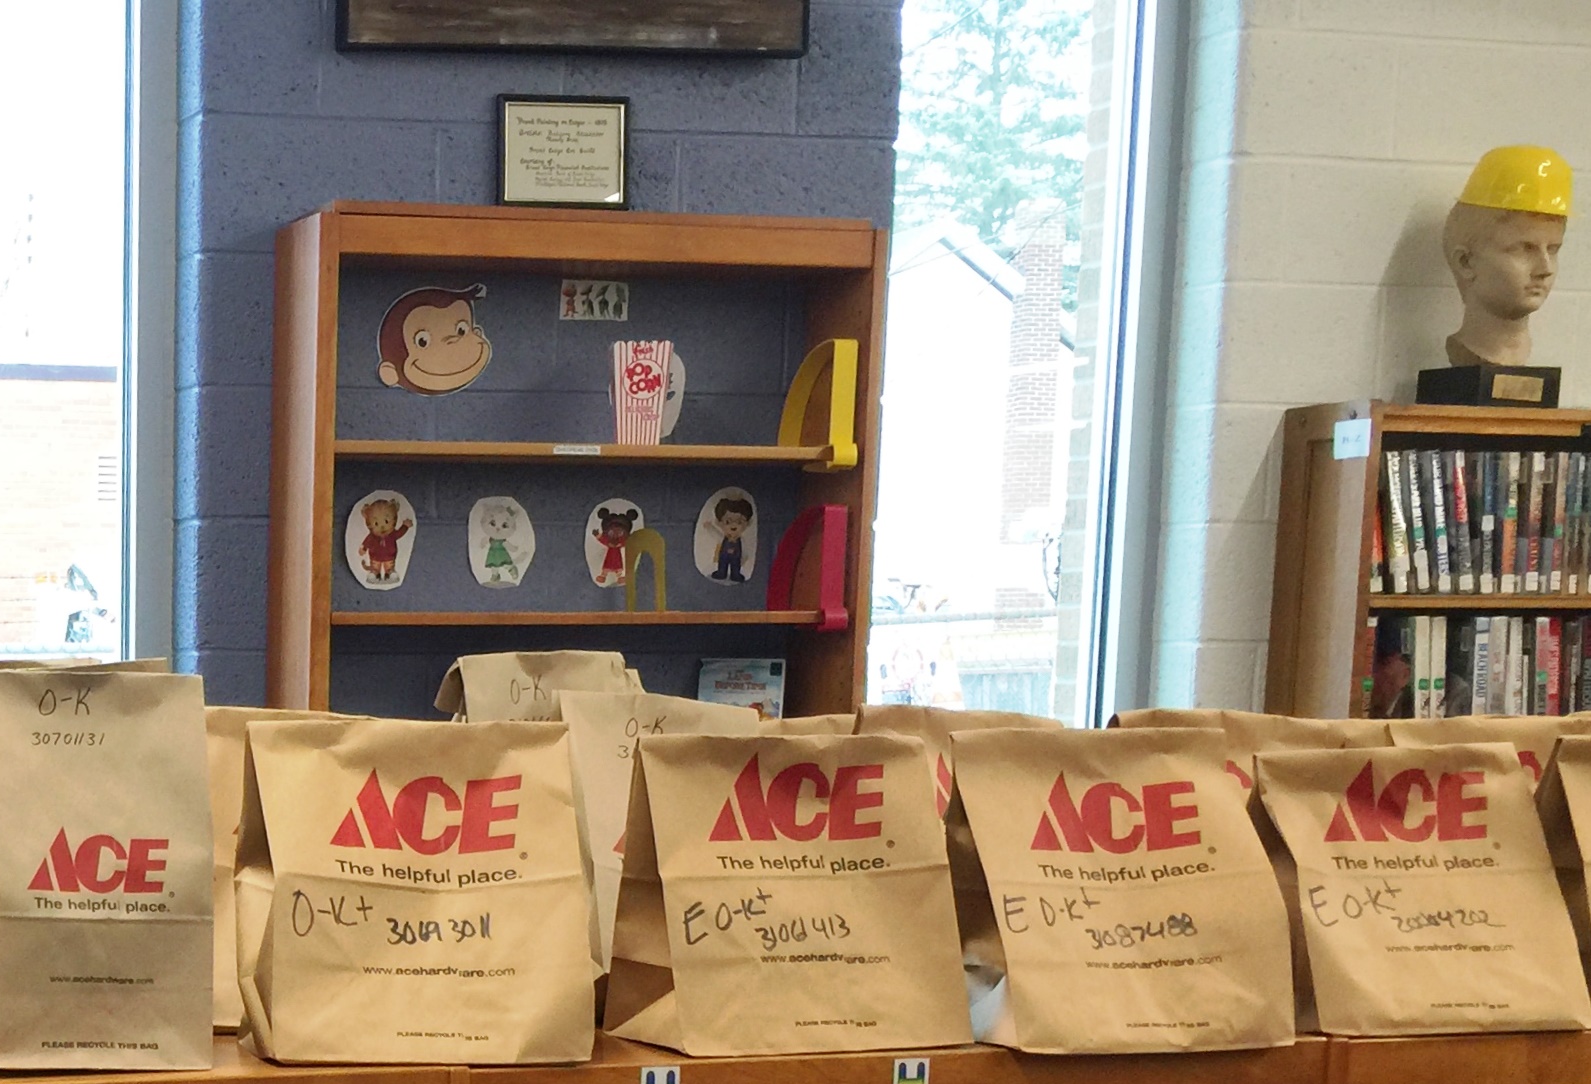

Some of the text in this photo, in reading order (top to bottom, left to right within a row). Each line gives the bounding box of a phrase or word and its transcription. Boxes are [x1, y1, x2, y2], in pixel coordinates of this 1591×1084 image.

[625, 362, 653, 382] POP
[629, 374, 661, 394] CORN
[329, 767, 523, 856] ACE
[709, 752, 884, 842] ACE
[1030, 770, 1201, 854] ACE
[1324, 759, 1488, 843] ACE
[27, 826, 170, 894] ACE
[335, 860, 522, 888] The helpful place.
[716, 853, 890, 875] The helpful place.
[1038, 861, 1216, 885] The helpful place.
[1332, 856, 1500, 871] The helpful place.
[34, 896, 171, 915] The helpful place.
[1002, 893, 1029, 934] E
[1309, 885, 1338, 927] E
[683, 901, 709, 946] E
[41, 1041, 75, 1049] PLEASE
